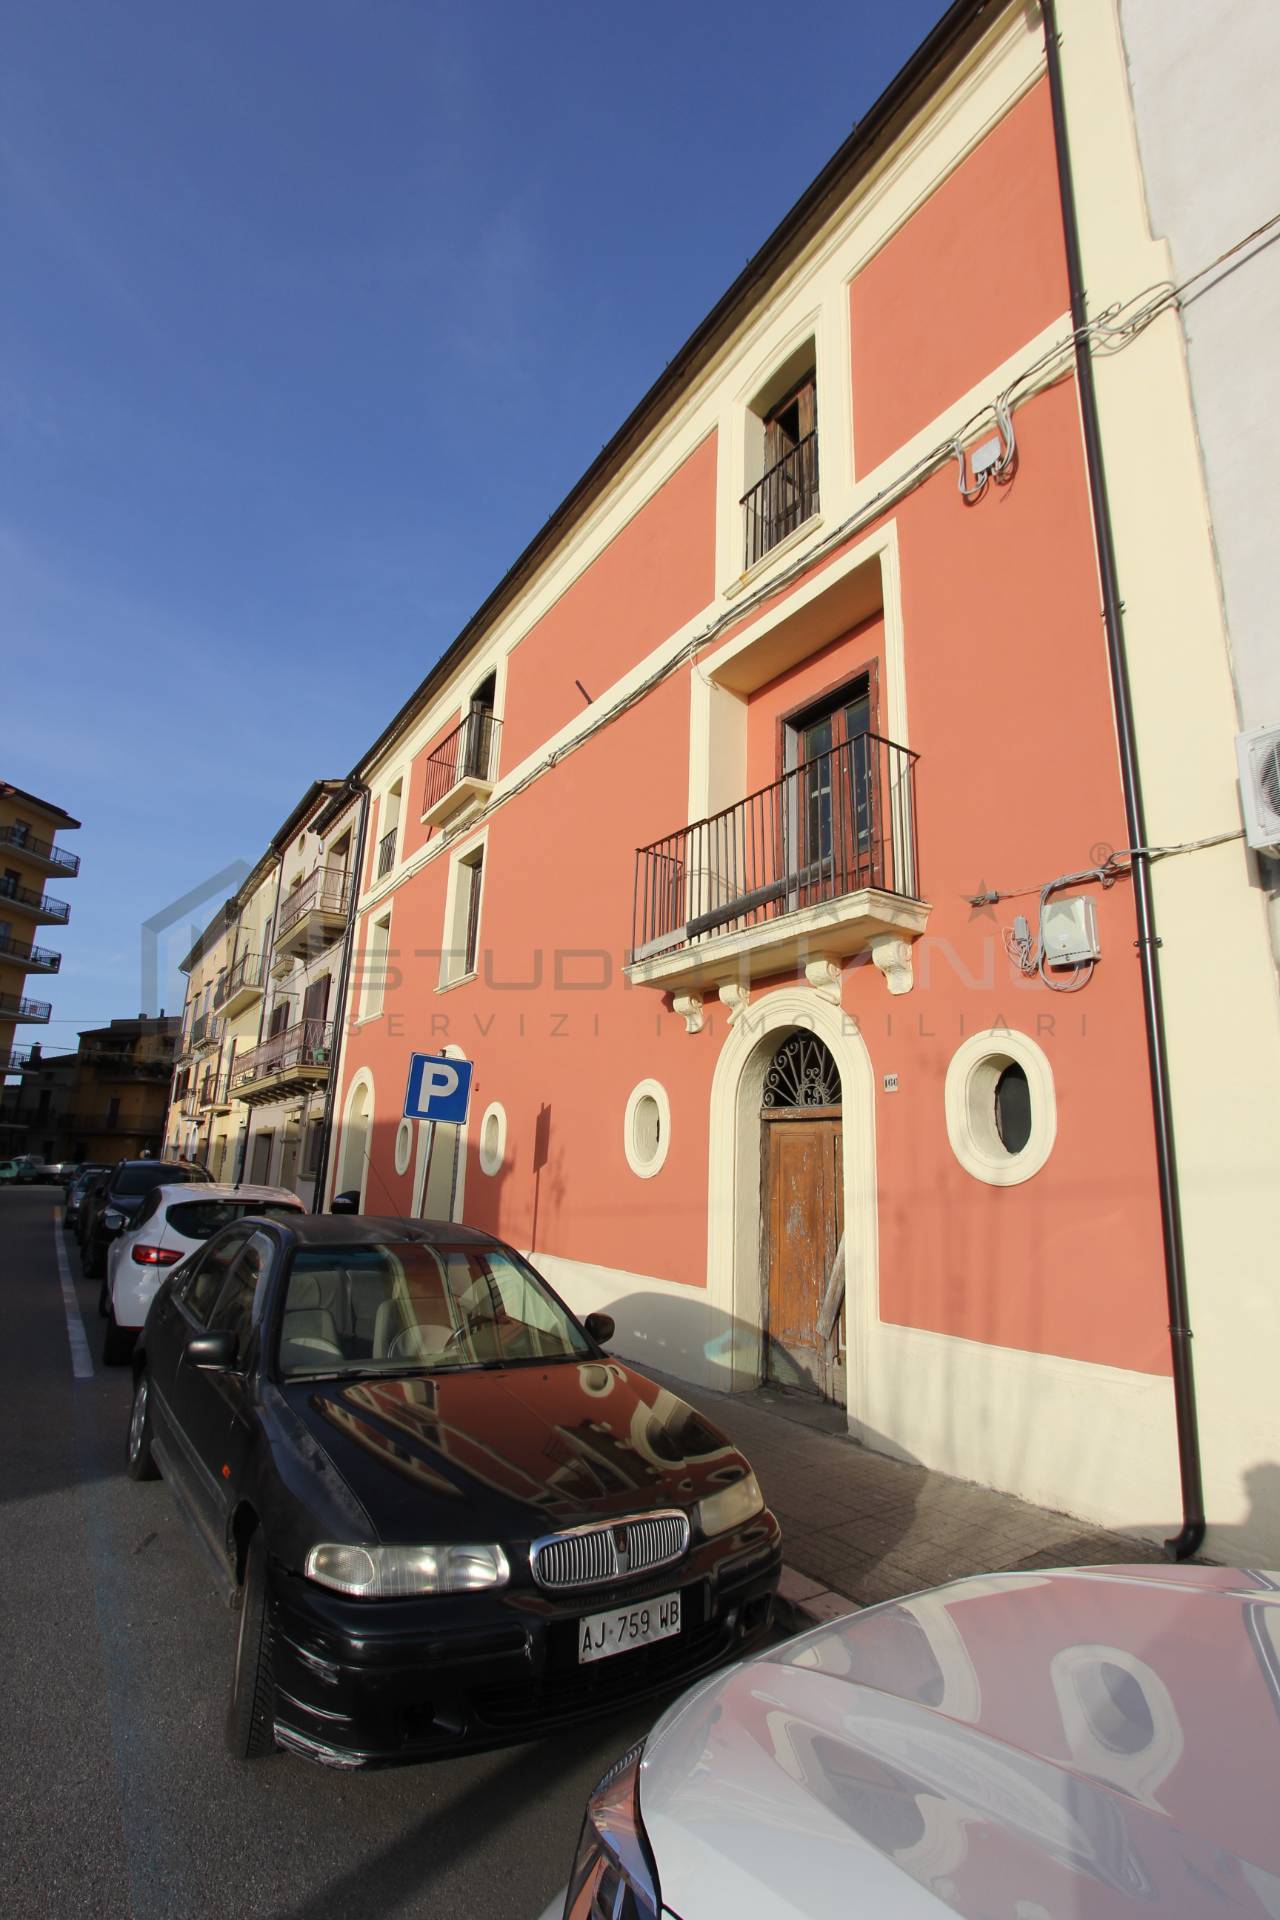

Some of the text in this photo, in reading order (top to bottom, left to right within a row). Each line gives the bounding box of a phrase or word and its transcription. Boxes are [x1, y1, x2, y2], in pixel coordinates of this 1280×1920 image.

[417, 1062, 459, 1113] P
[582, 1600, 680, 1654] AJ 759 WB
